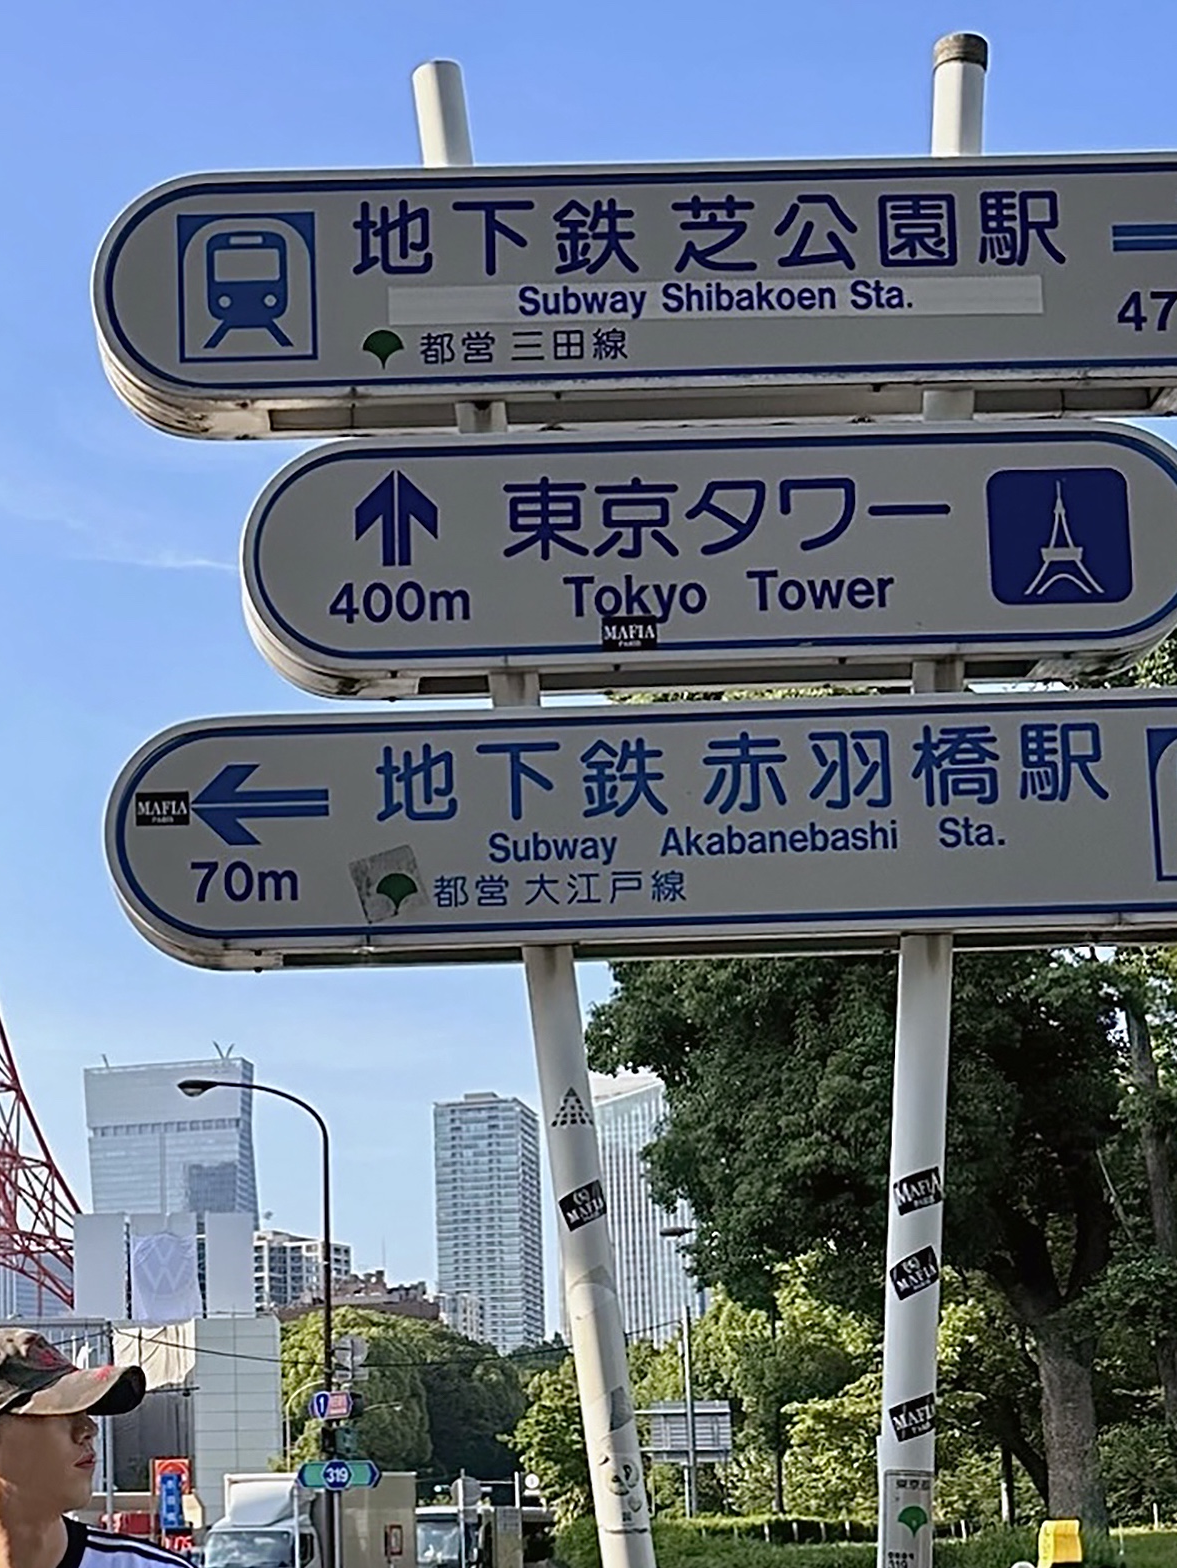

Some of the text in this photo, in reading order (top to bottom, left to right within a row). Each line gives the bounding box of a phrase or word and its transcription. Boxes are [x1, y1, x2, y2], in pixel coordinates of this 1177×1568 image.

[352, 190, 1067, 277] 地下鉄 芝公園駅
[517, 279, 914, 320] Subway Shibakoen Sta.
[502, 475, 951, 561] 東京タワー
[328, 579, 471, 624] 400m
[563, 568, 895, 624] Tokyo Tower
[603, 624, 656, 640] MAFIA
[375, 721, 1110, 822] 地下鉄 赤羽橋駅
[137, 800, 188, 816] MAFIA
[488, 817, 1007, 868] Subway Akabanebashi Sta.
[189, 861, 299, 903] 70m
[895, 1171, 942, 1206] MAFIA
[896, 1263, 937, 1293] MAFIA
[326, 1467, 349, 1483] 319
